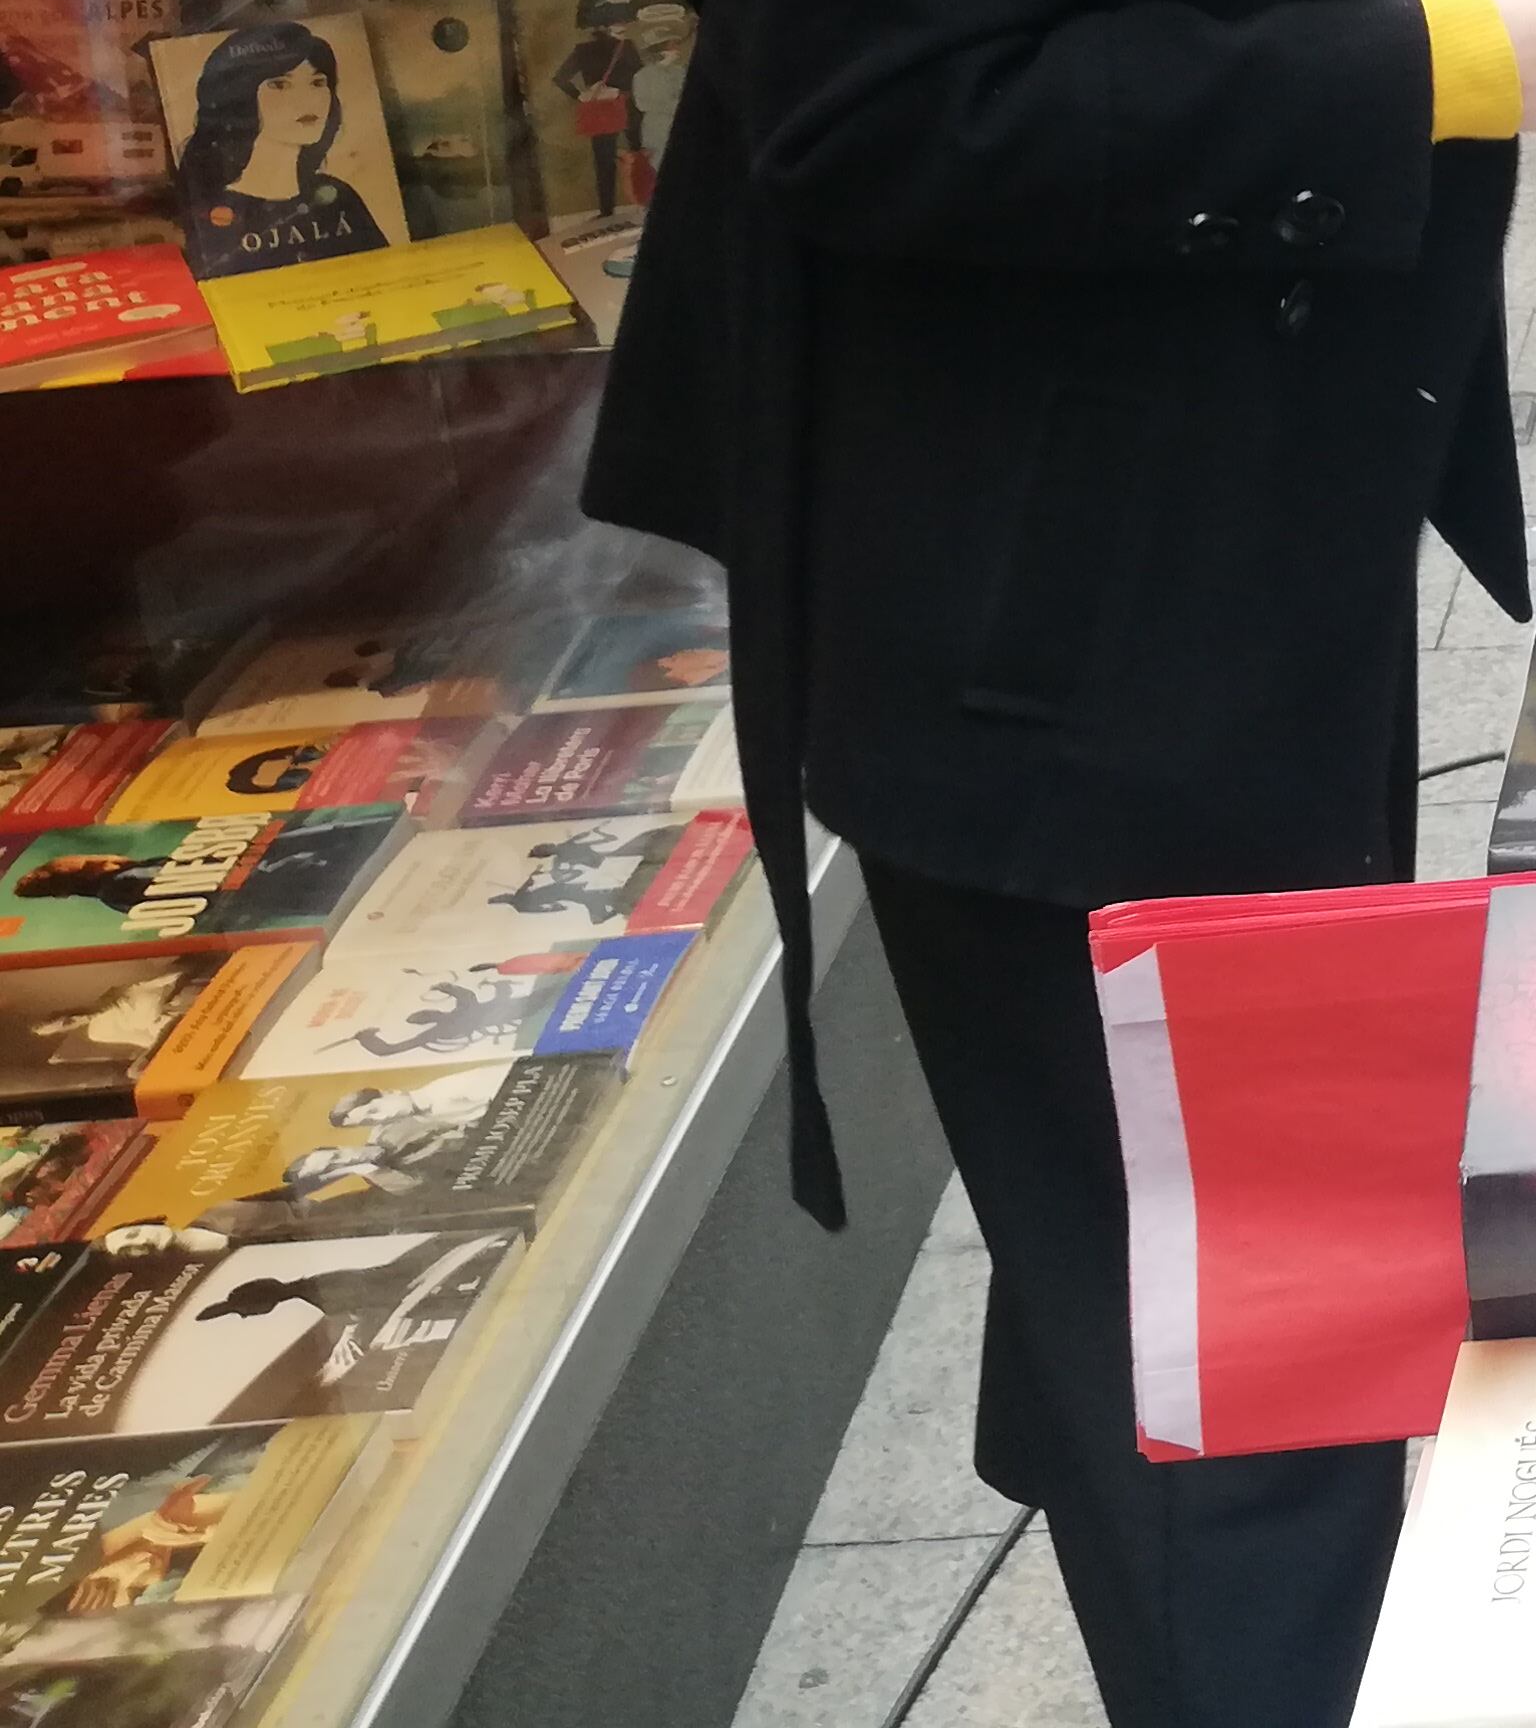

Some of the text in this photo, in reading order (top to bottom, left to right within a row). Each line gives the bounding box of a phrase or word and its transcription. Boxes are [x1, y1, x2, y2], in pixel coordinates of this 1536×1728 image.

[241, 215, 353, 253] OJALÁ
[3, 1325, 80, 1425] Gemma
[26, 1471, 130, 1587] MARES
[1491, 1530, 1534, 1605] JORDI
